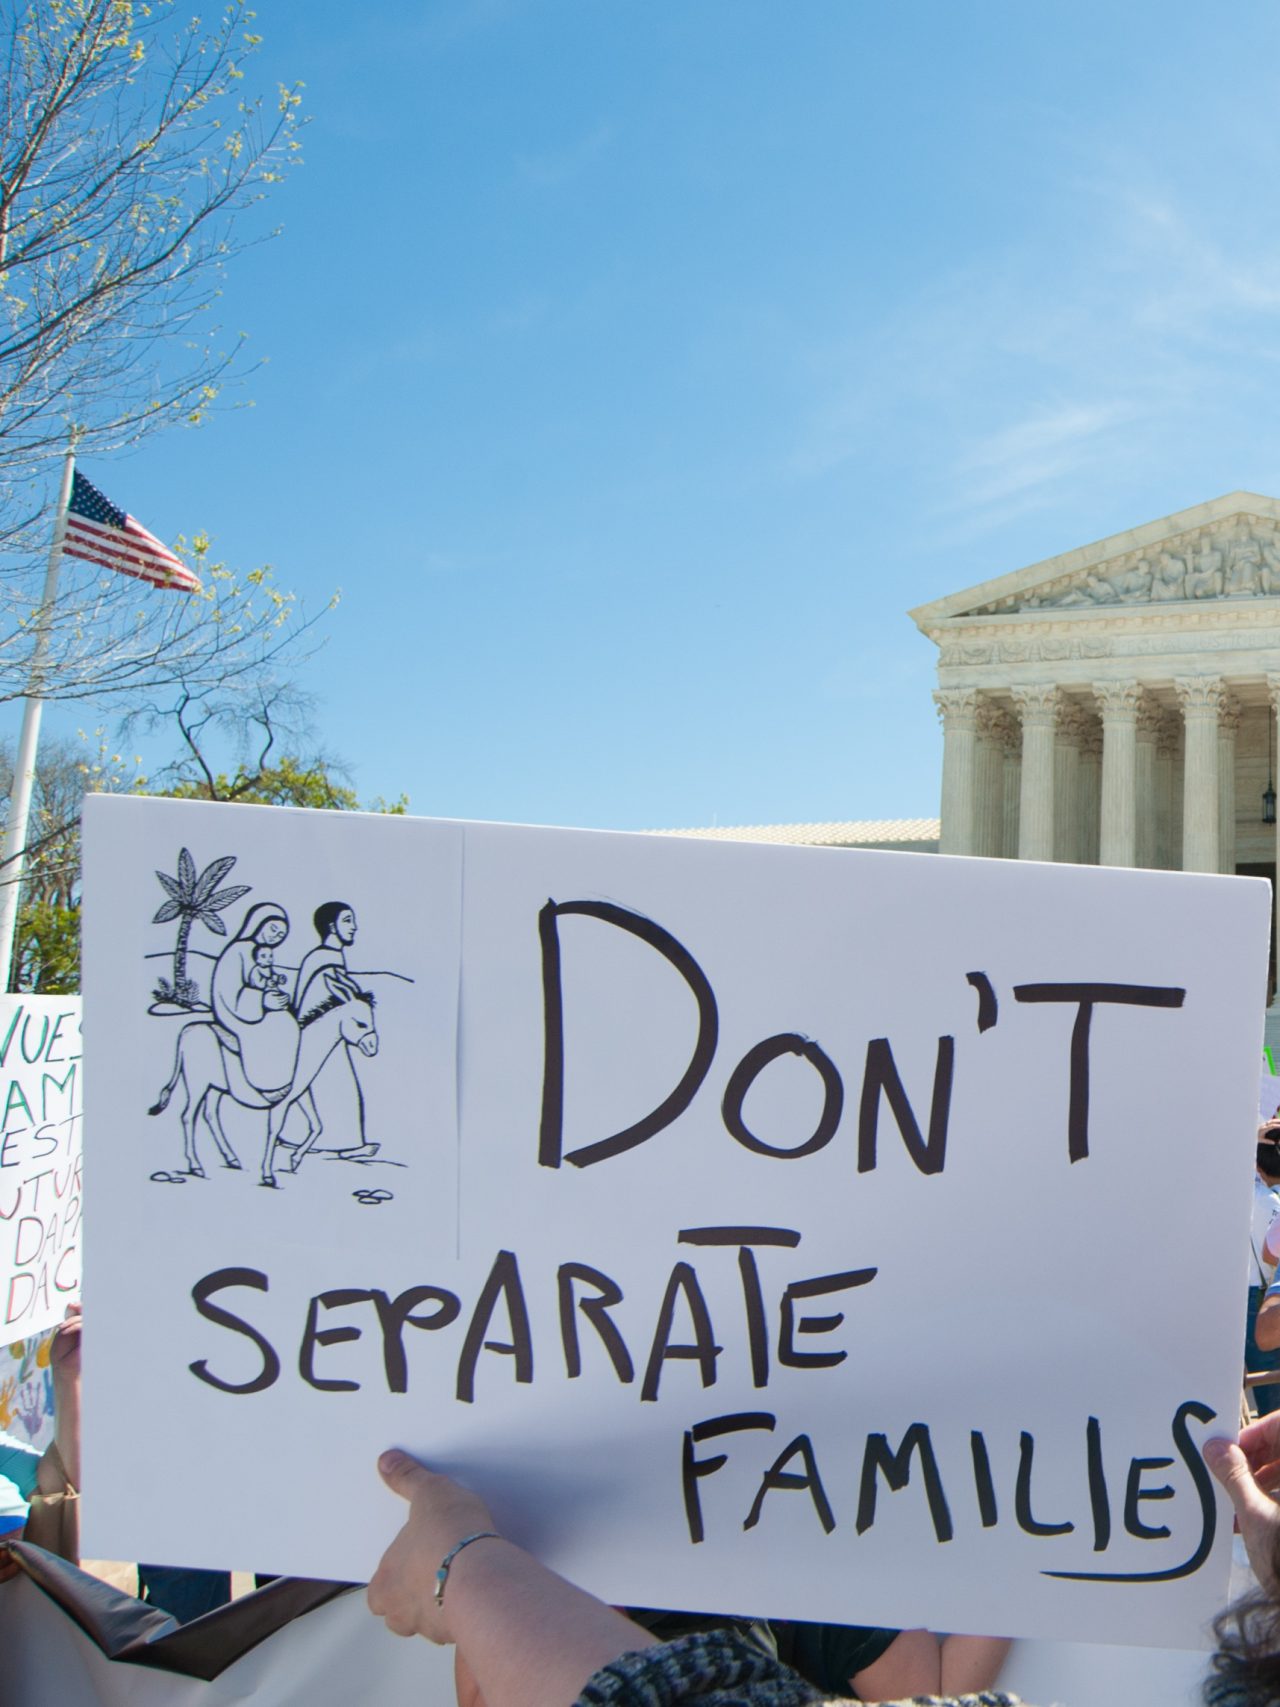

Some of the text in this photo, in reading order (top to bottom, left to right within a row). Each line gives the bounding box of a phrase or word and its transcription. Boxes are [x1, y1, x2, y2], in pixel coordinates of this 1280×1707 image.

[537, 896, 1188, 1176] DON'T
[187, 1225, 879, 1404] SEPARATE
[682, 1400, 1219, 1584] FAMILIES
